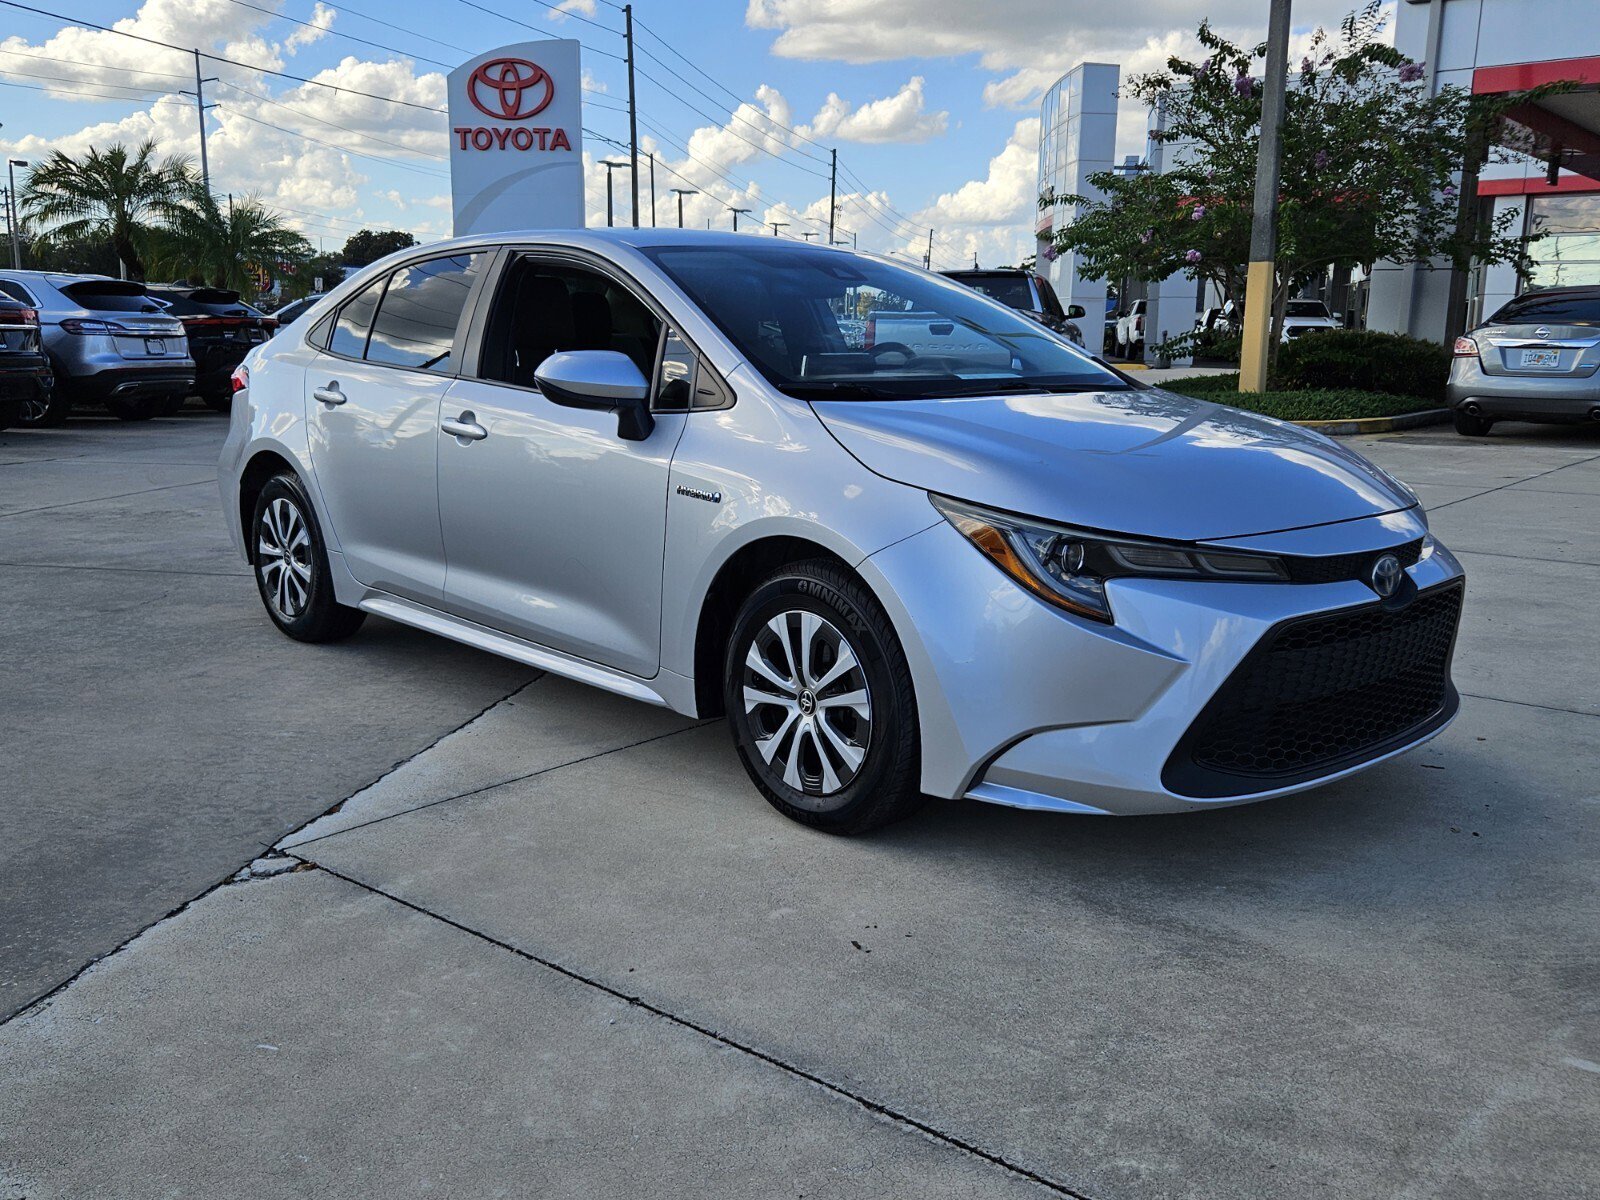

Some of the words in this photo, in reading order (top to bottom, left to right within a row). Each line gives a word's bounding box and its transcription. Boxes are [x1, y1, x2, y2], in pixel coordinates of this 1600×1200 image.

[453, 127, 571, 151] TOYOTA
[676, 485, 713, 502] HYBRID
[798, 580, 867, 637] OMNIMAX
